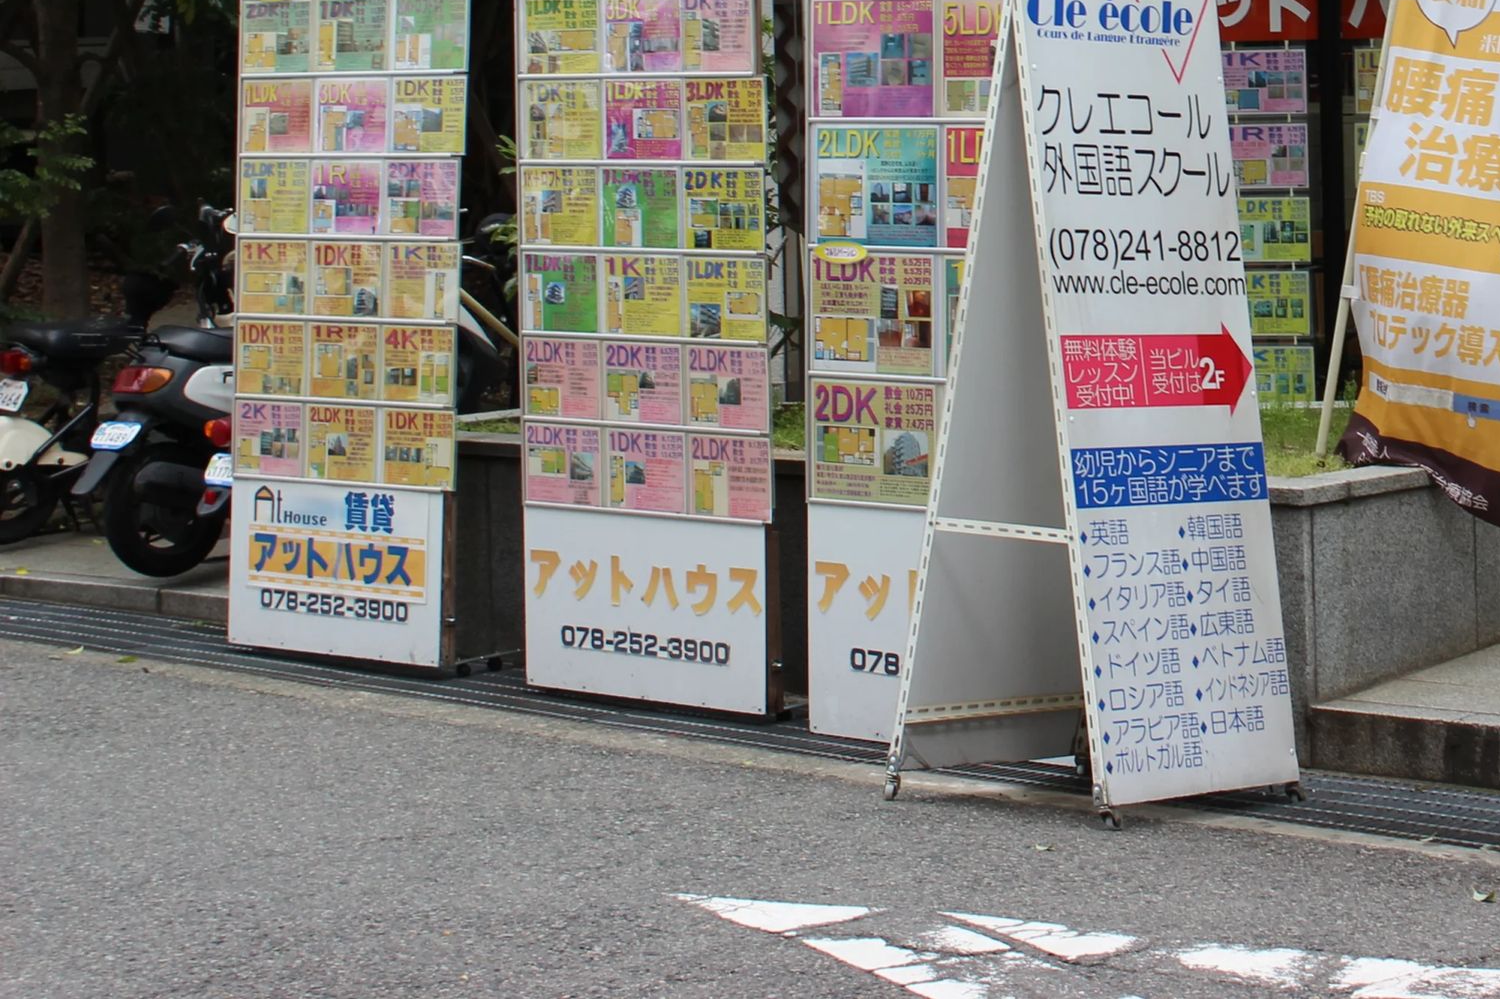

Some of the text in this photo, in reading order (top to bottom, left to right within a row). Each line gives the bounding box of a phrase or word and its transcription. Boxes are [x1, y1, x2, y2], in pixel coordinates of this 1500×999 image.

[320, 1, 355, 19] 1DK
[814, 0, 876, 26] 1LDK
[1037, 28, 1068, 40] Cours
[1070, 29, 1085, 41] de
[1086, 31, 1127, 44] Langue
[1223, 53, 1261, 67] 1K
[319, 83, 353, 104] 3DK
[395, 79, 430, 98] 1DK
[606, 82, 644, 102] 1LDK
[686, 82, 725, 101] 3LDK
[1385, 56, 1500, 127] 腰痛
[1037, 85, 1212, 140] クレエコール
[818, 130, 881, 159] 2LDK
[316, 164, 348, 185] 1R
[388, 162, 422, 180] 2DK
[685, 170, 723, 191] 2DK
[1044, 142, 1231, 197] 外国語スクール
[1365, 188, 1386, 204] TBS
[243, 243, 275, 261] 1K
[315, 245, 349, 266] 1DK
[392, 245, 425, 262] 1K
[1050, 228, 1242, 269] (078)241-8812
[525, 254, 562, 273] 1LDK
[604, 257, 642, 276] 1K
[687, 260, 725, 281] 1LDK
[813, 256, 877, 283] 1LDK
[1052, 270, 1248, 297] www.cle-ecole.com
[240, 324, 272, 345] 1DK
[313, 325, 345, 339] 1R
[384, 328, 420, 350] 4K
[527, 341, 563, 365] 2LDK
[606, 344, 645, 368] 2DK
[688, 348, 729, 373] 2LDK
[1063, 337, 1138, 362] 無料体験
[1150, 348, 1201, 371] 当ビル
[1067, 362, 1139, 384] レッスン
[1151, 357, 1225, 395] 受付は 2F
[815, 384, 880, 425] 2DK
[906, 387, 935, 402] 10万円
[1075, 384, 1137, 408] 受付中!
[241, 403, 268, 421] 2K
[310, 407, 342, 425] 2LDK
[386, 411, 420, 431] 1DK
[905, 402, 935, 417] 25万円
[528, 427, 564, 446] 2LDK
[905, 417, 935, 432] 7.4万円
[609, 432, 643, 454] 1DK
[692, 437, 731, 461] 2LDK
[1074, 446, 1256, 479] 幼児からシニアまで
[284, 510, 328, 527] House
[344, 490, 396, 535] 賃貸
[1089, 519, 1130, 547] 英語
[1187, 512, 1243, 541] 韓国語
[253, 532, 412, 587] アットハウス
[1093, 548, 1182, 579] フランス語
[1191, 544, 1248, 574] 中国語
[530, 548, 763, 617] アットハウス
[1196, 576, 1251, 605] タイ語
[260, 588, 409, 623] 078-252-3900
[1099, 581, 1187, 612] イタリア語
[1102, 613, 1190, 646] スペイン語
[1200, 608, 1256, 637] 広東語
[560, 624, 731, 665] 078-252-3900
[1202, 637, 1286, 668] ベトナム語
[850, 647, 900, 677] 078
[1107, 647, 1182, 679] ドイツ語
[1109, 680, 1185, 711] ロシア語
[1205, 669, 1290, 702] インドネシア語
[1113, 712, 1200, 746] アラビア語
[1210, 705, 1266, 735] 日本語
[1115, 741, 1204, 775] ポルトガル語
